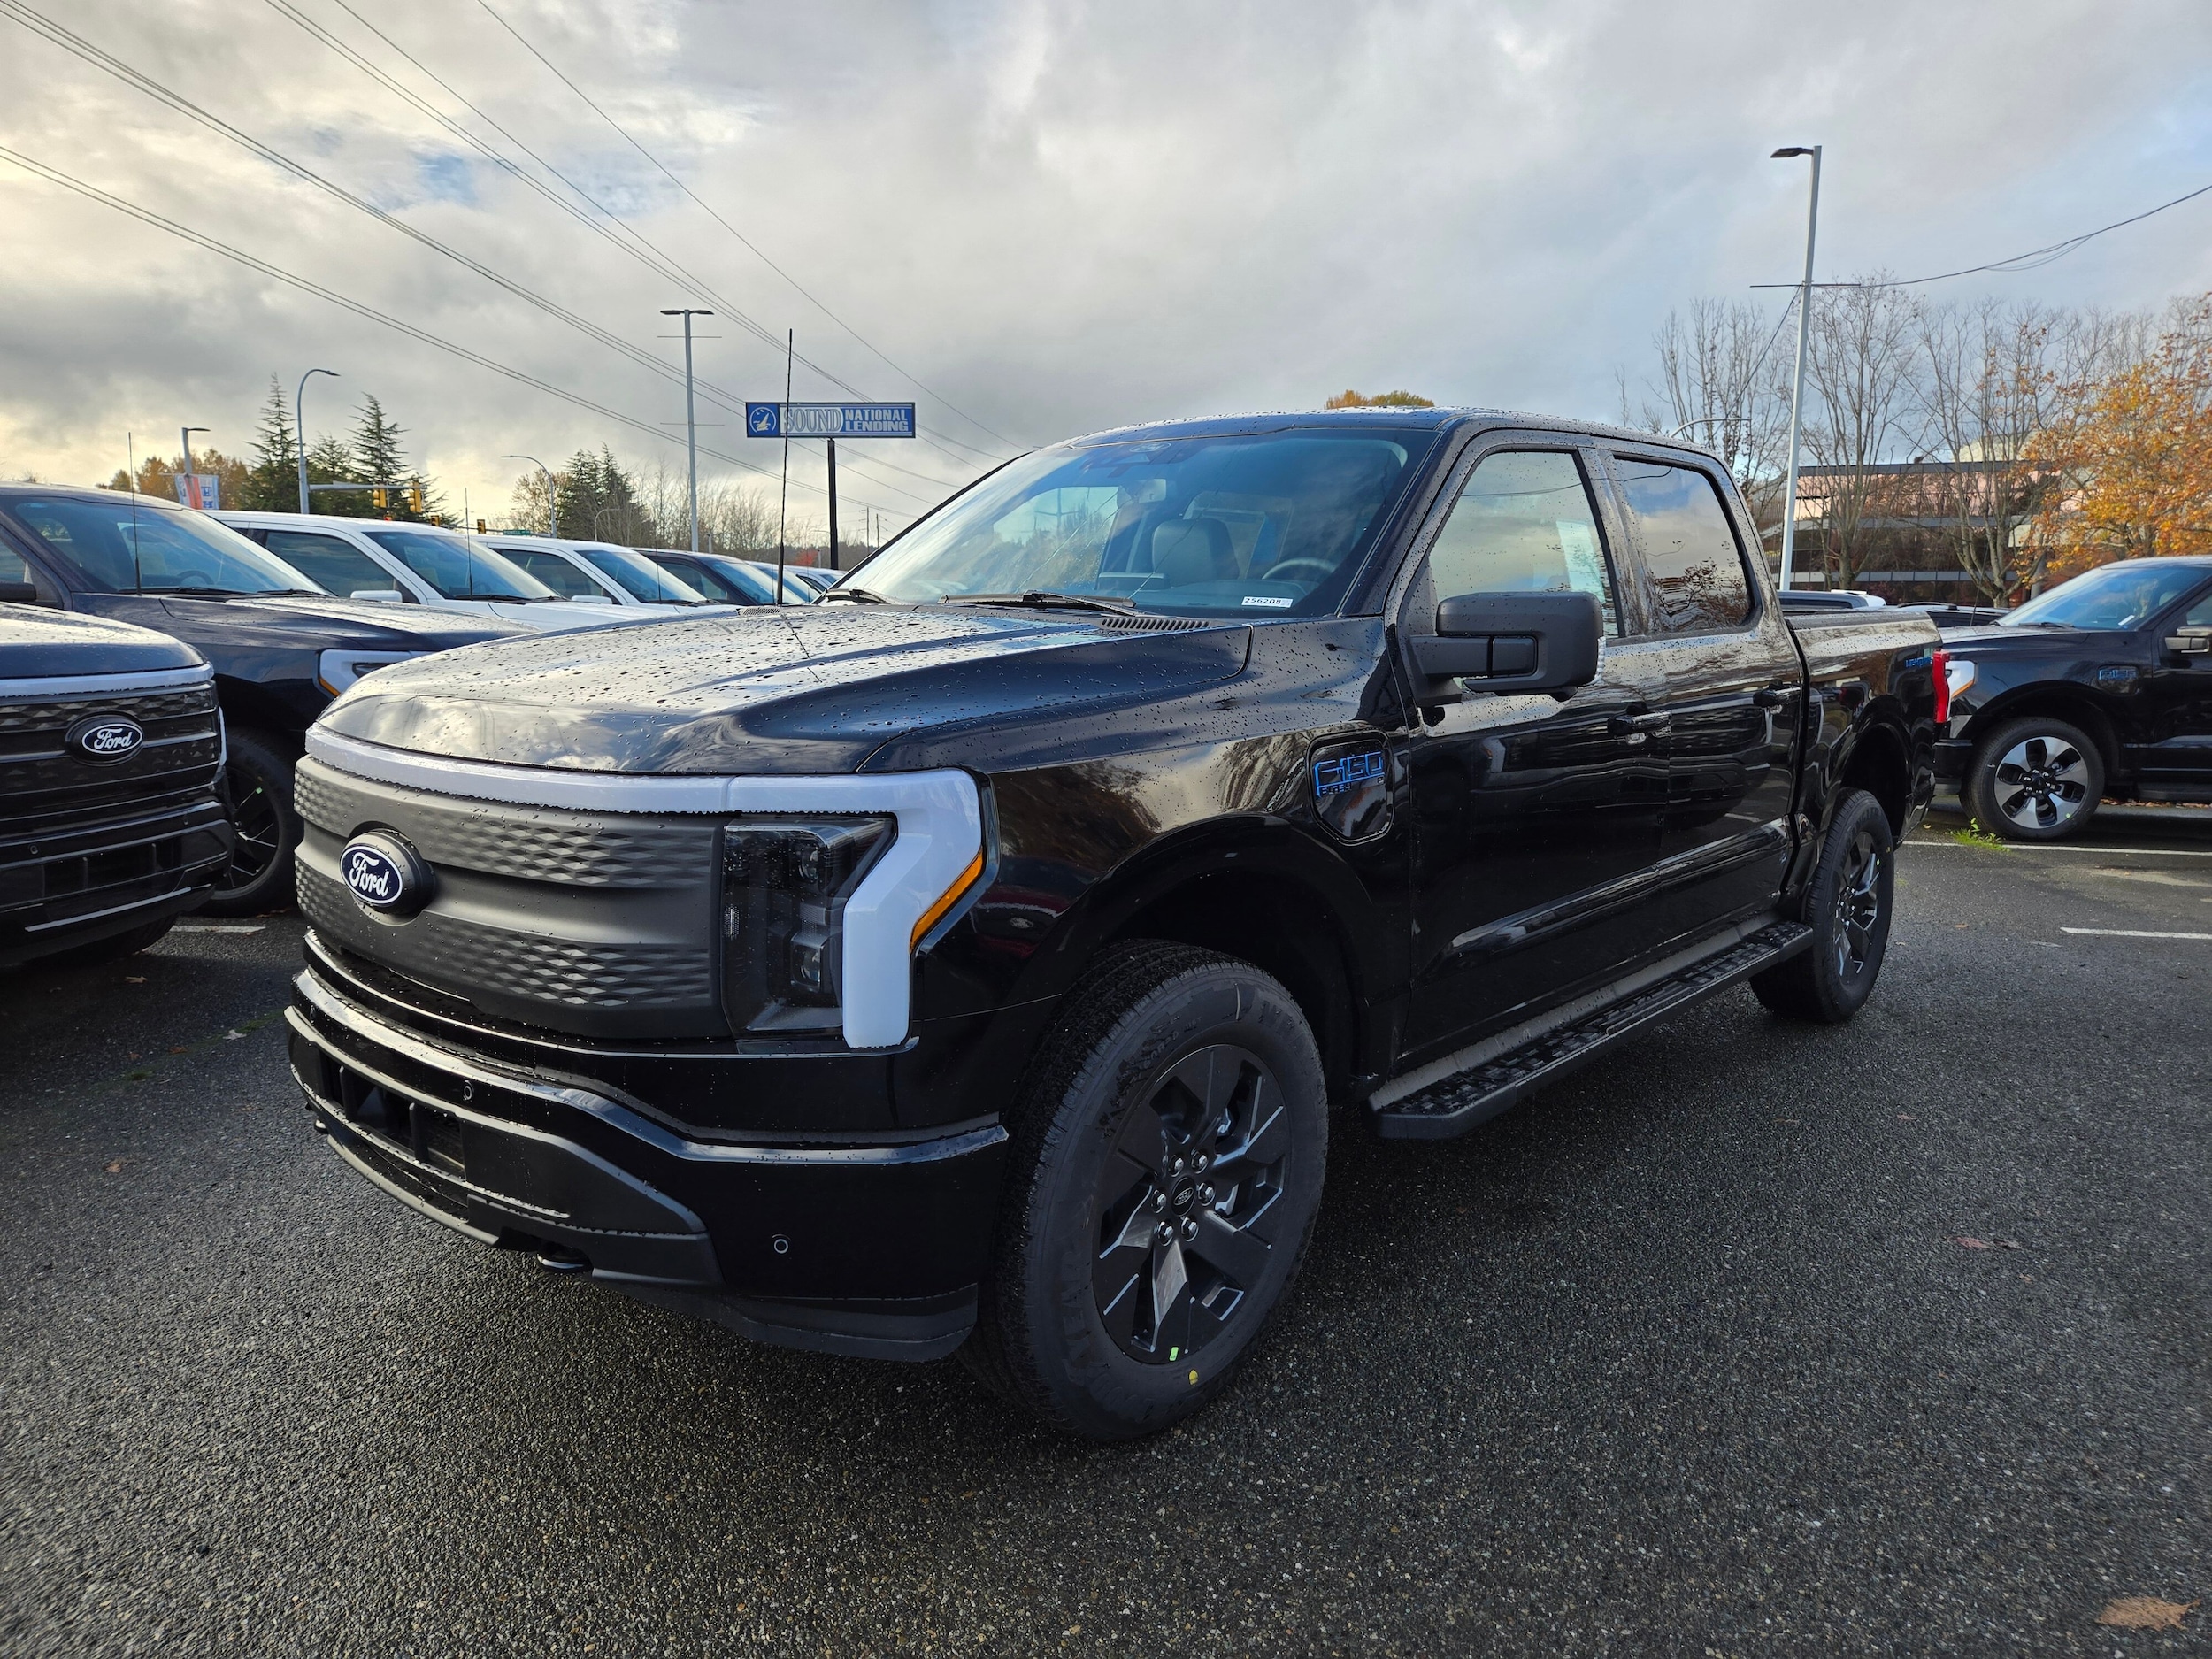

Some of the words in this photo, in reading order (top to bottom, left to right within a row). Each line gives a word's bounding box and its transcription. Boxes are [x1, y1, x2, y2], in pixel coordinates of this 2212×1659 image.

[783, 407, 841, 432] SOUND
[845, 408, 908, 421] NATIONAL
[845, 420, 909, 432] LENDING
[93, 727, 133, 750] Ford
[349, 851, 390, 897] Ford
